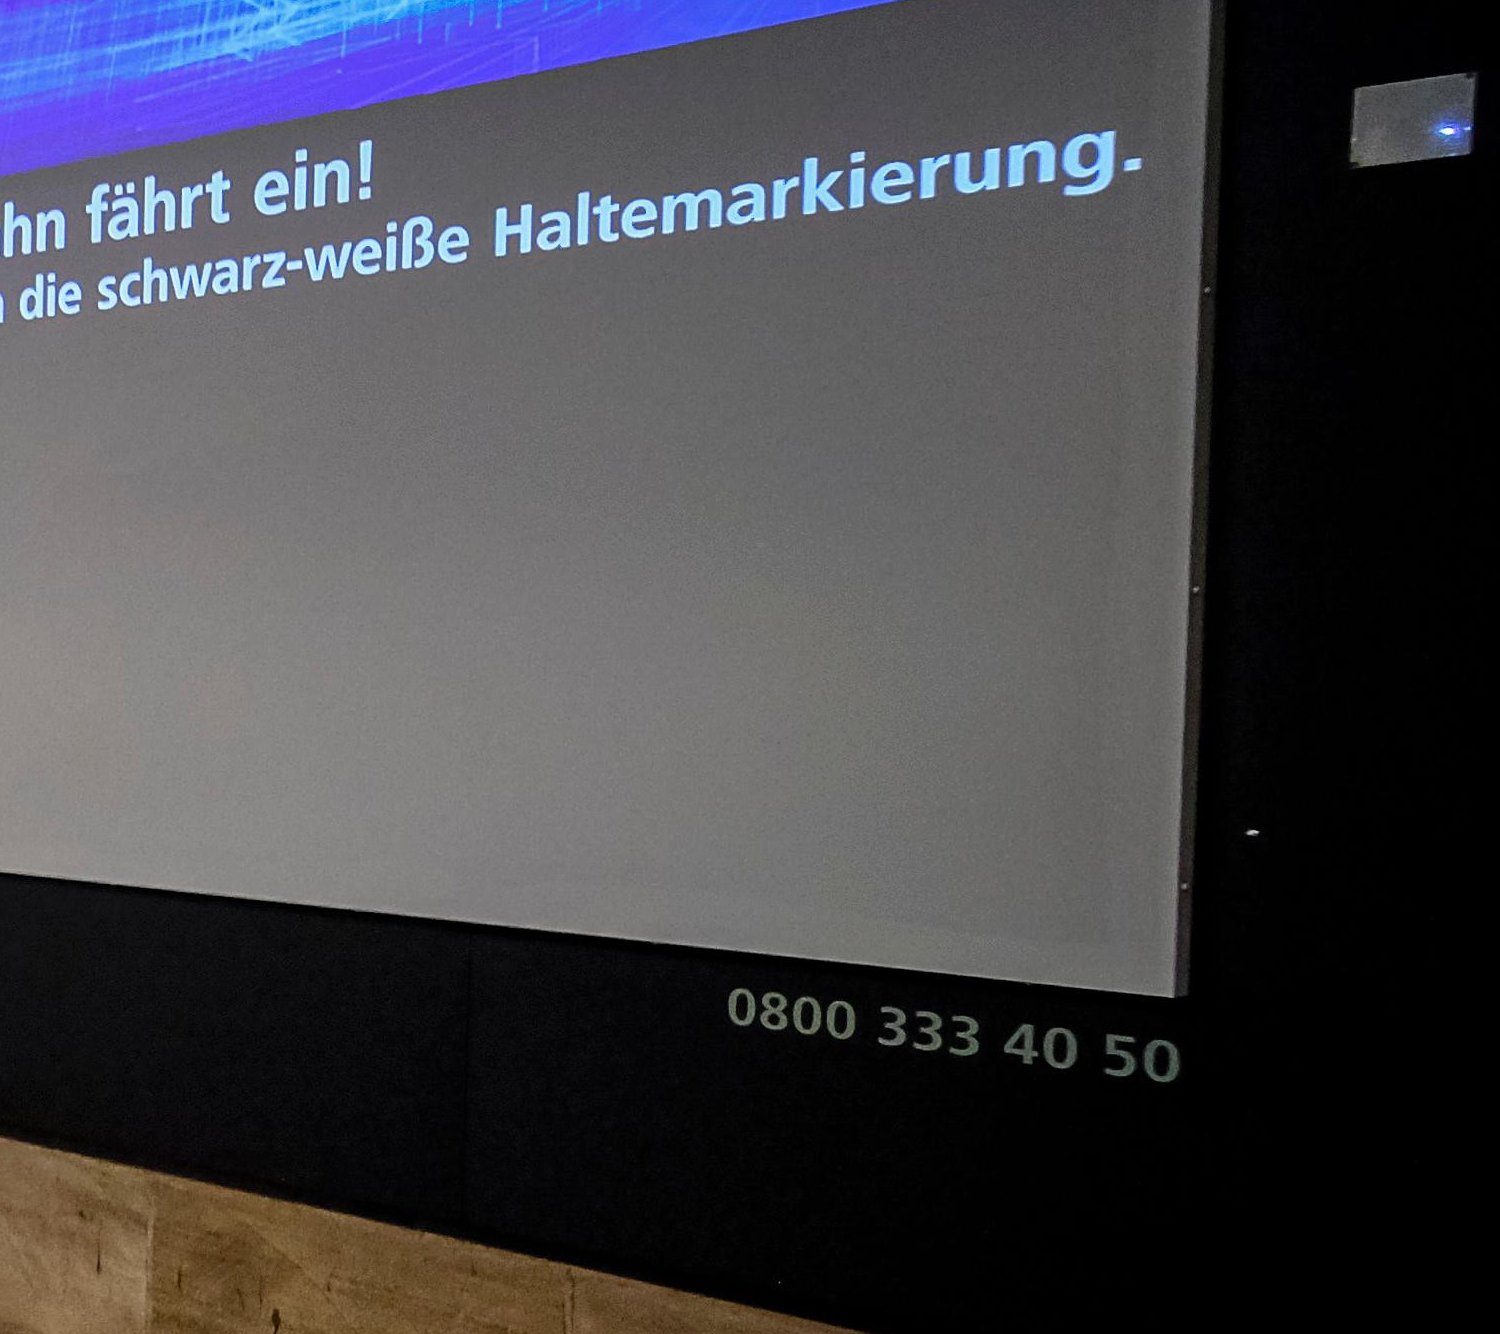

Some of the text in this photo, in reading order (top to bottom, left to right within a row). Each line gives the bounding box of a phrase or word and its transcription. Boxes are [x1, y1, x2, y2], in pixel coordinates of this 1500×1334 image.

[19, 272, 83, 326] die
[97, 213, 471, 311] schwarz-weiße
[493, 129, 1144, 258] Haltemarkierung.
[86, 169, 232, 243] fährt
[254, 140, 375, 217] ein!
[727, 987, 1181, 1083] 0800 333 40 50
